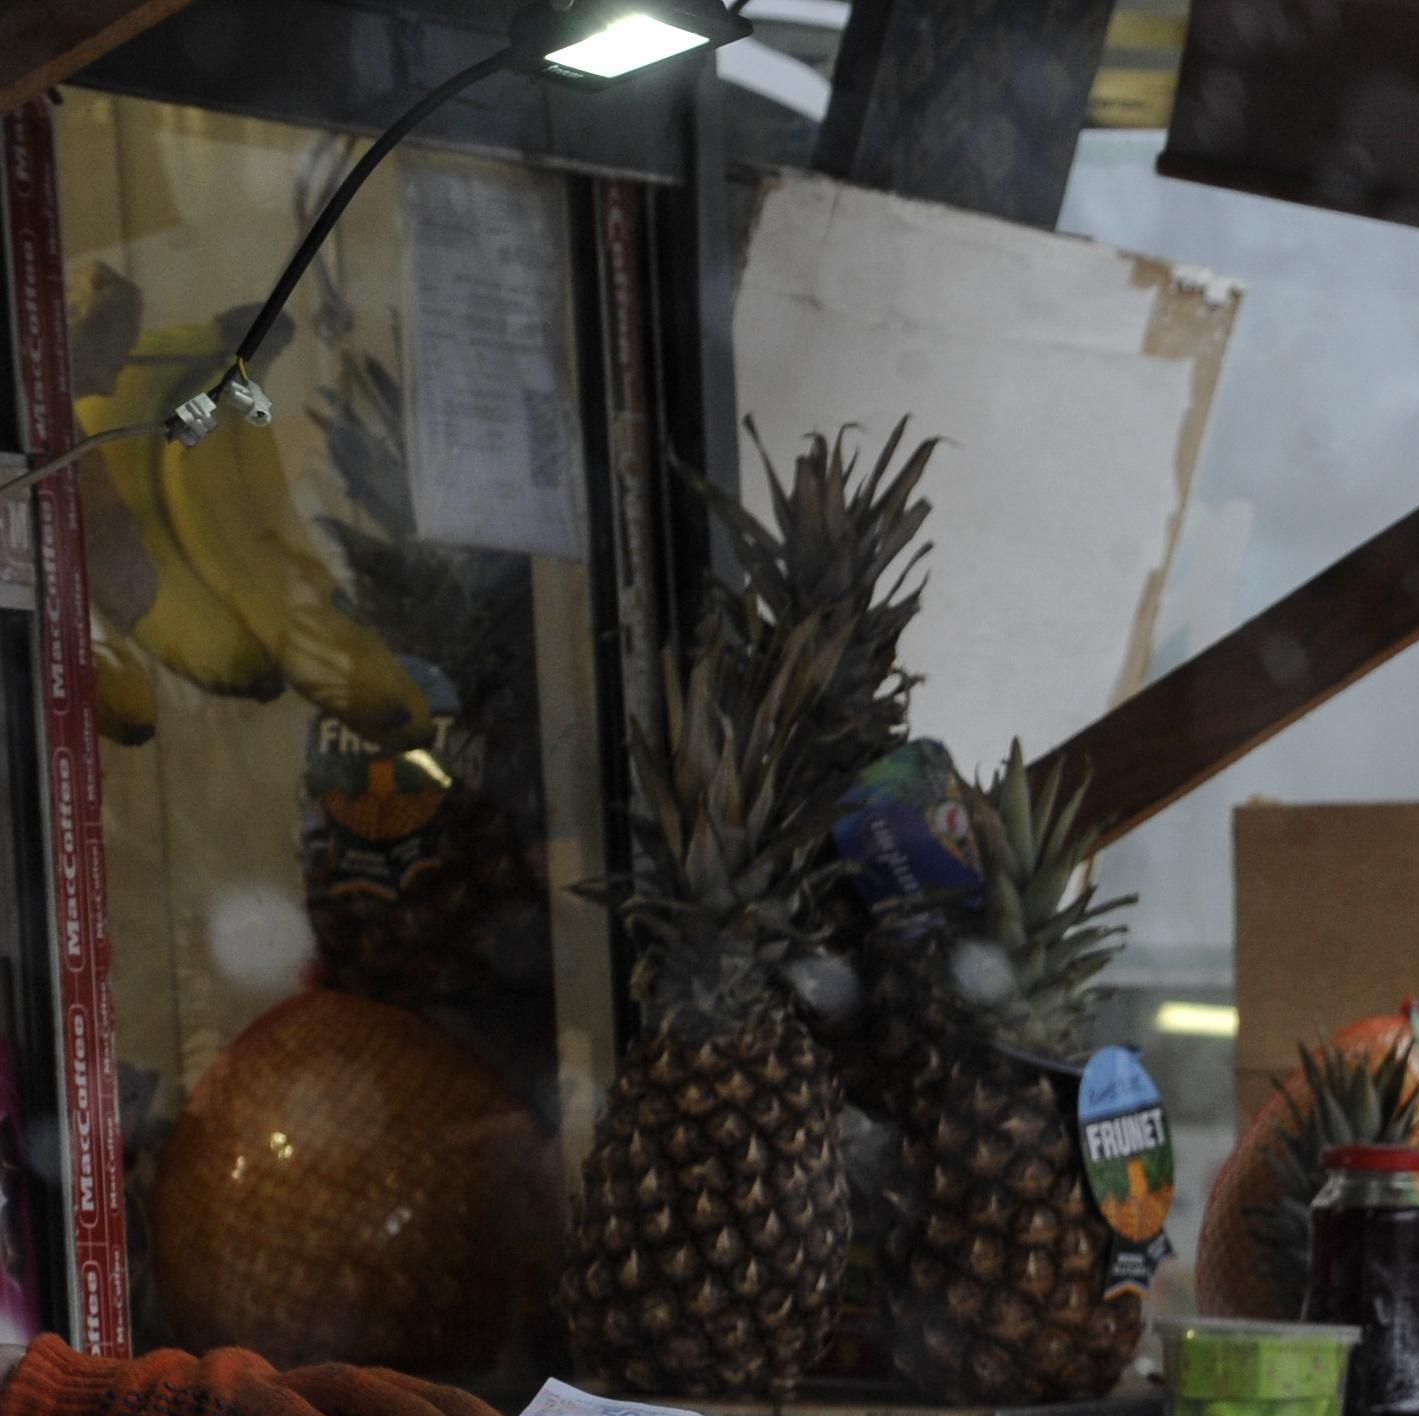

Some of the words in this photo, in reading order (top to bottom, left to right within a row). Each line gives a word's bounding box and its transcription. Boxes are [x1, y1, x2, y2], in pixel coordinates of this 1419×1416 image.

[40, 501, 66, 699] MacCoffee
[58, 757, 81, 955] MacCoffee
[73, 1015, 95, 1210] MacCoffee
[1086, 1107, 1167, 1162] FRUNET
